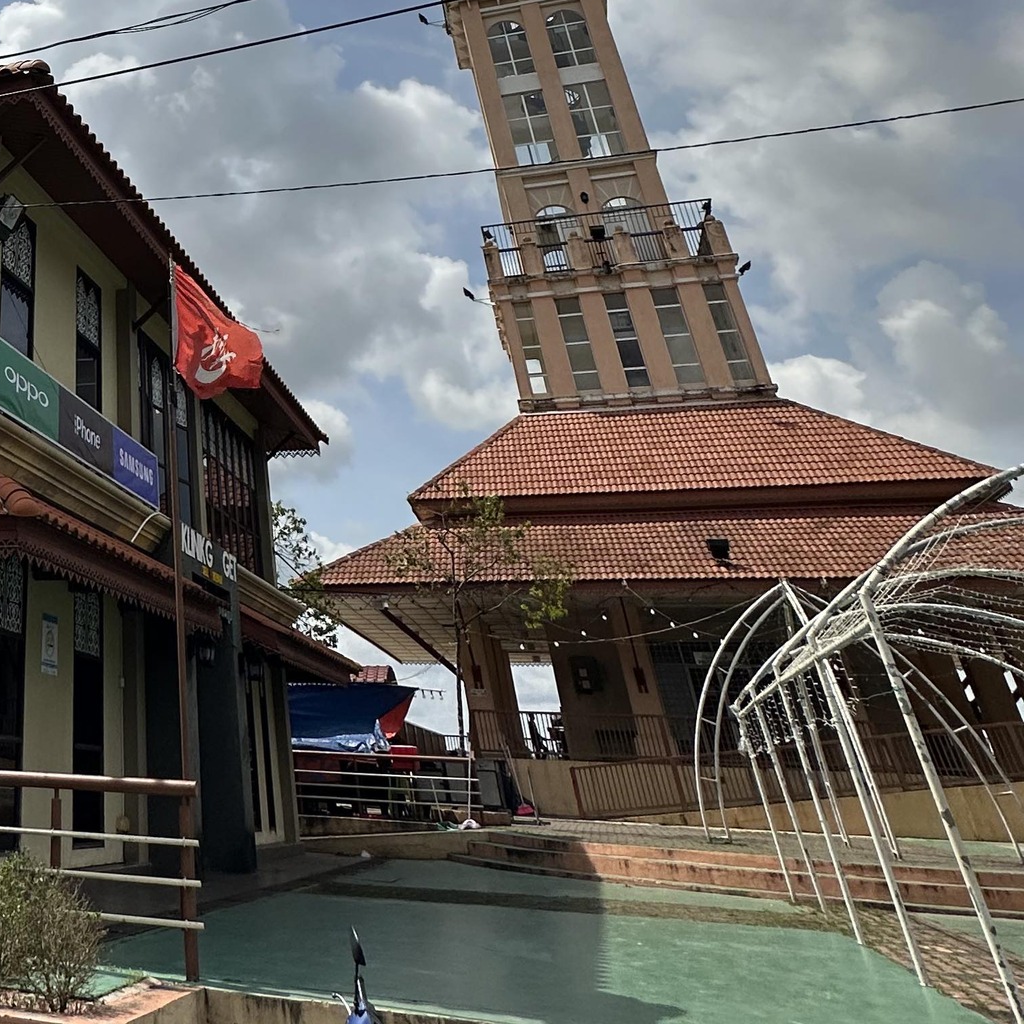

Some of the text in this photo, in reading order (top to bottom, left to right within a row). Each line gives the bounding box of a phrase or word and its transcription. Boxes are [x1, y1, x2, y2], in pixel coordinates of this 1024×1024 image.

[4, 366, 49, 408] oppo
[73, 414, 101, 450] iPhone
[119, 448, 154, 486] SAMSUNG
